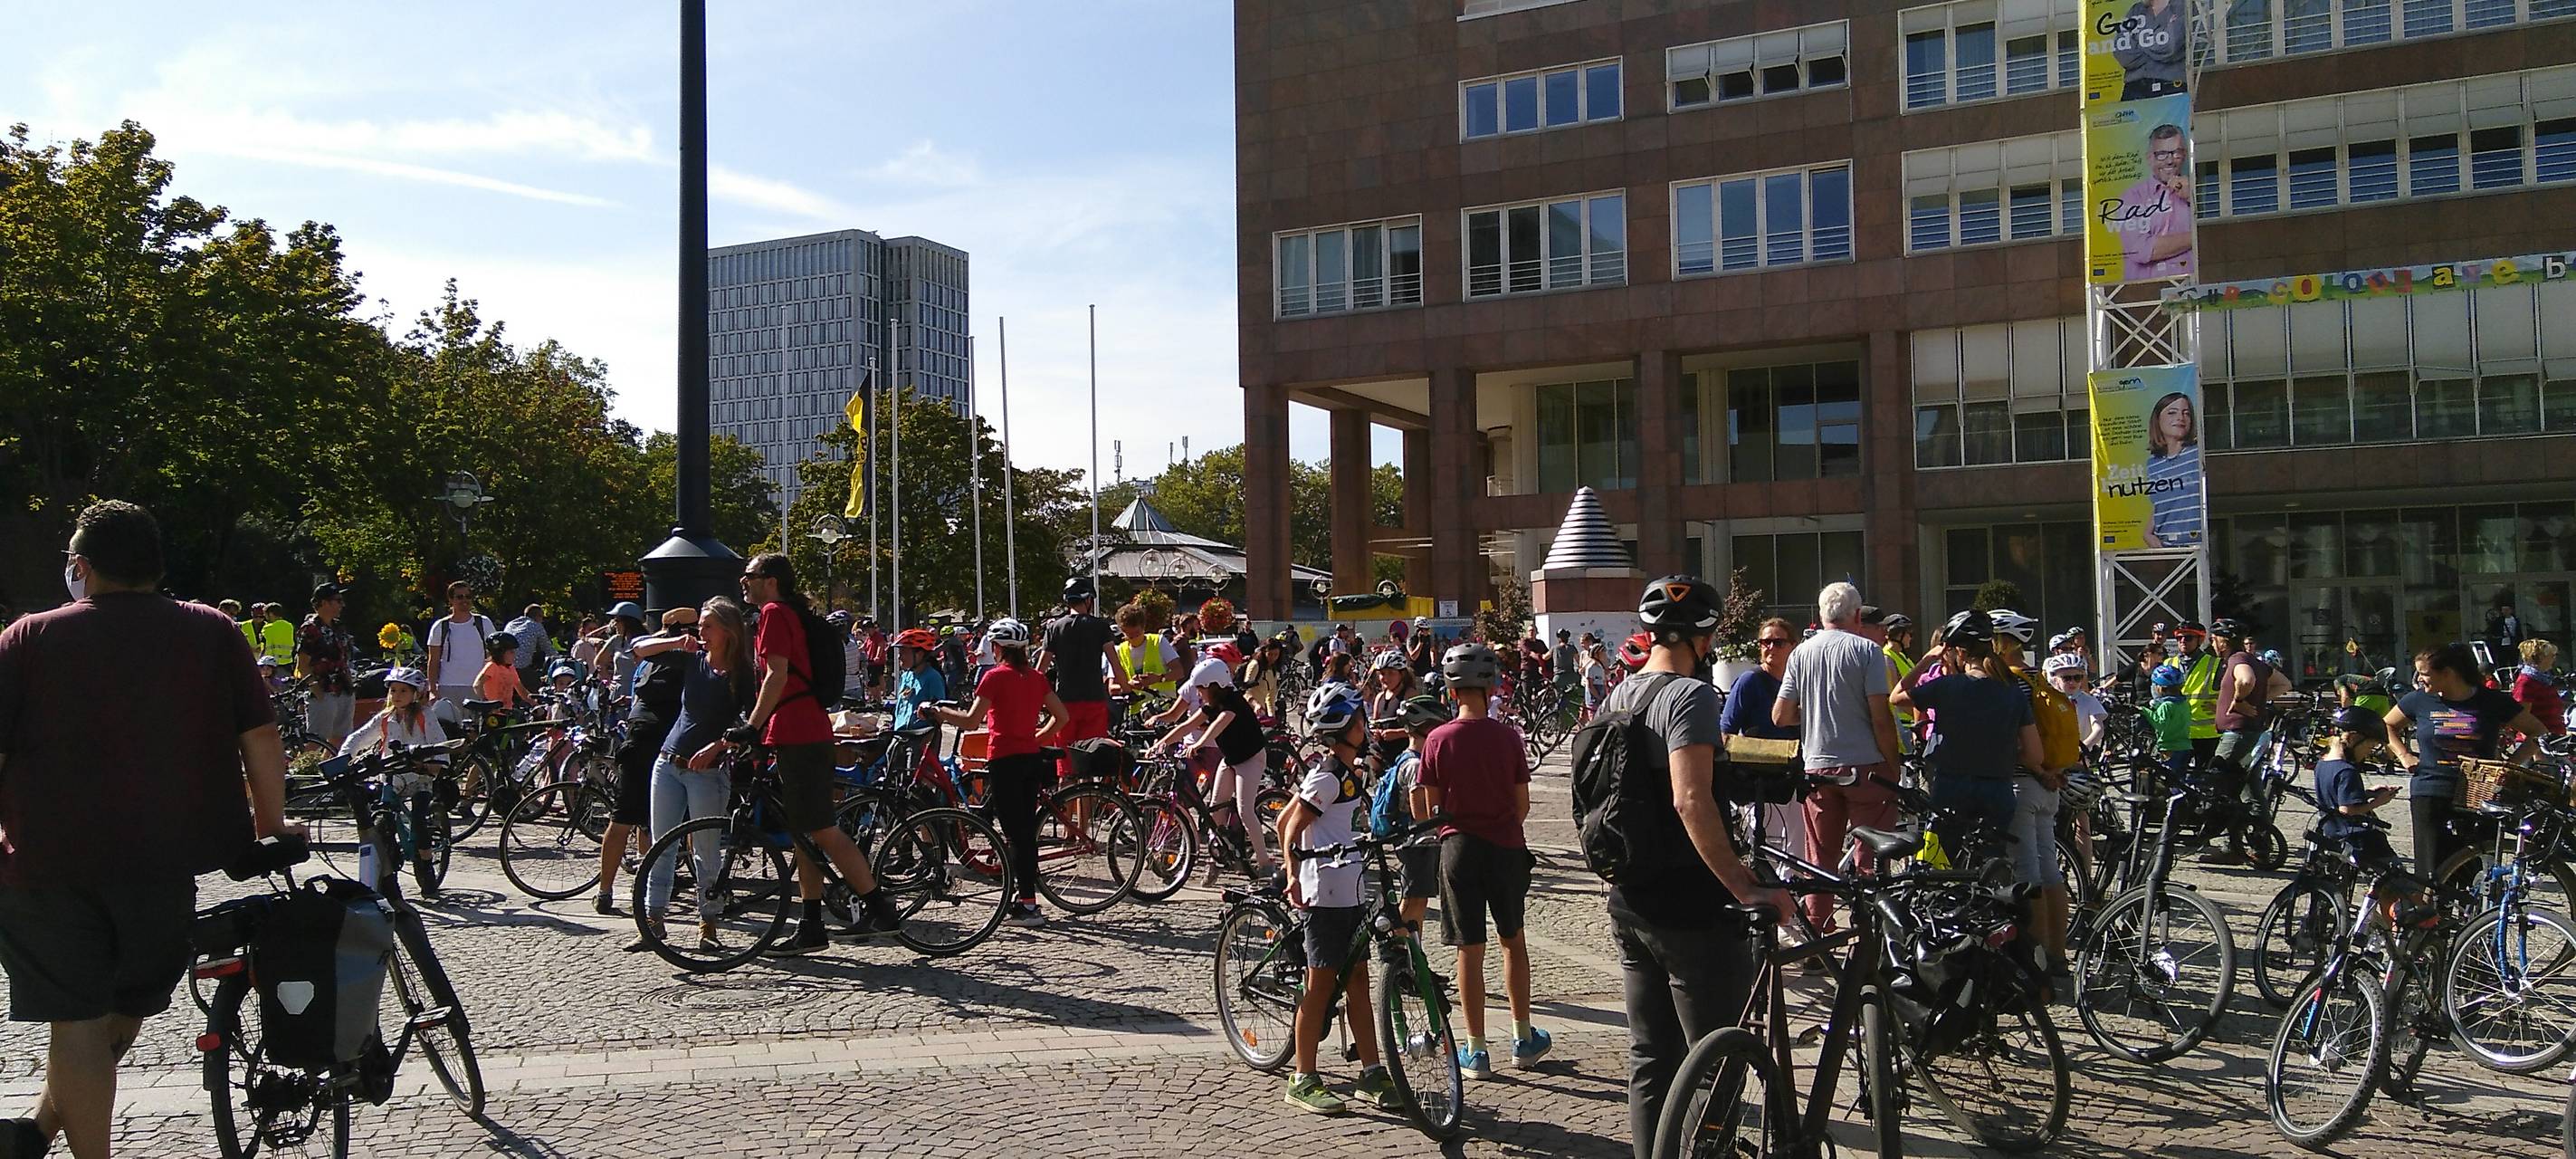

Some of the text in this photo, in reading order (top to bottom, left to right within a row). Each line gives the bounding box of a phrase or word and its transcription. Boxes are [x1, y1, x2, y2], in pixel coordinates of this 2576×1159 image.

[2096, 12, 2139, 35] Go
[2138, 28, 2170, 48] Go
[2097, 189, 2171, 225] Rad
[2108, 476, 2184, 498] nutzen
